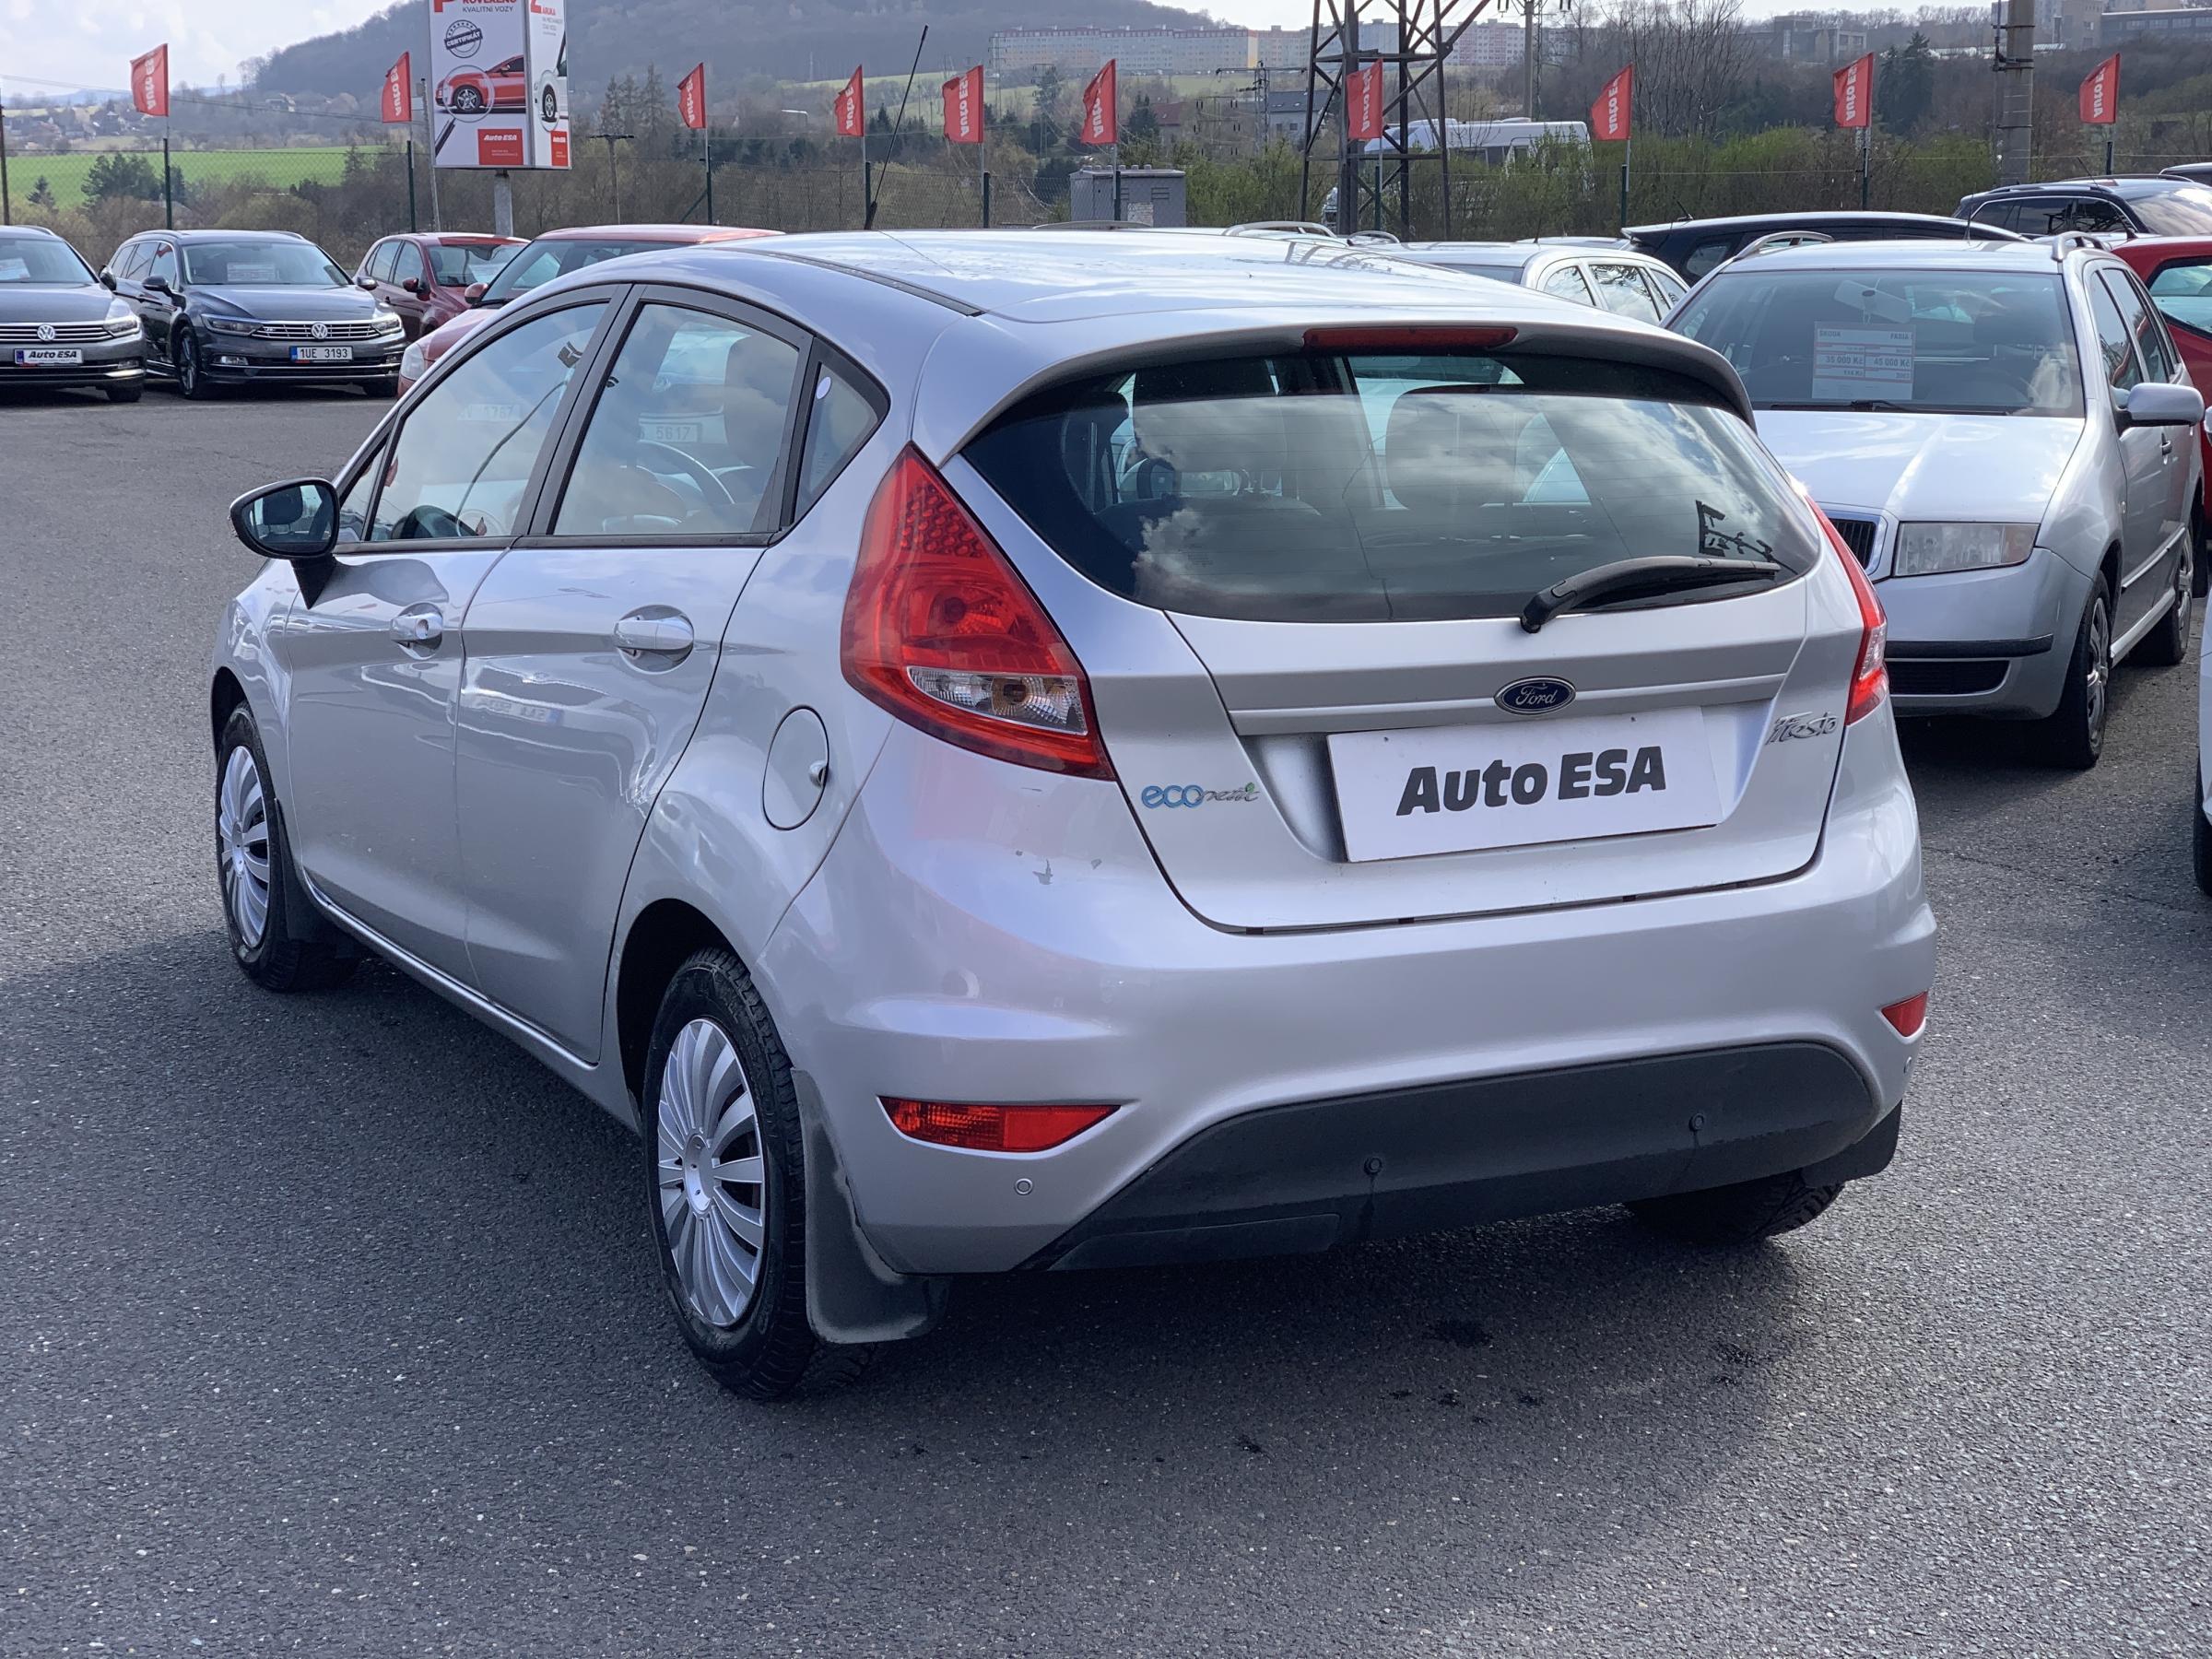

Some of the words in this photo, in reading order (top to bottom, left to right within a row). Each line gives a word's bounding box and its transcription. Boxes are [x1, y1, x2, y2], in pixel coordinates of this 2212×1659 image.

[29, 350, 55, 359] Auto
[57, 350, 77, 359] ESA
[300, 348, 317, 359] 1UE
[324, 348, 347, 359] 3193
[1515, 682, 1558, 705] Ford
[1395, 759, 1548, 817] Auto
[1558, 746, 1666, 800] ESA
